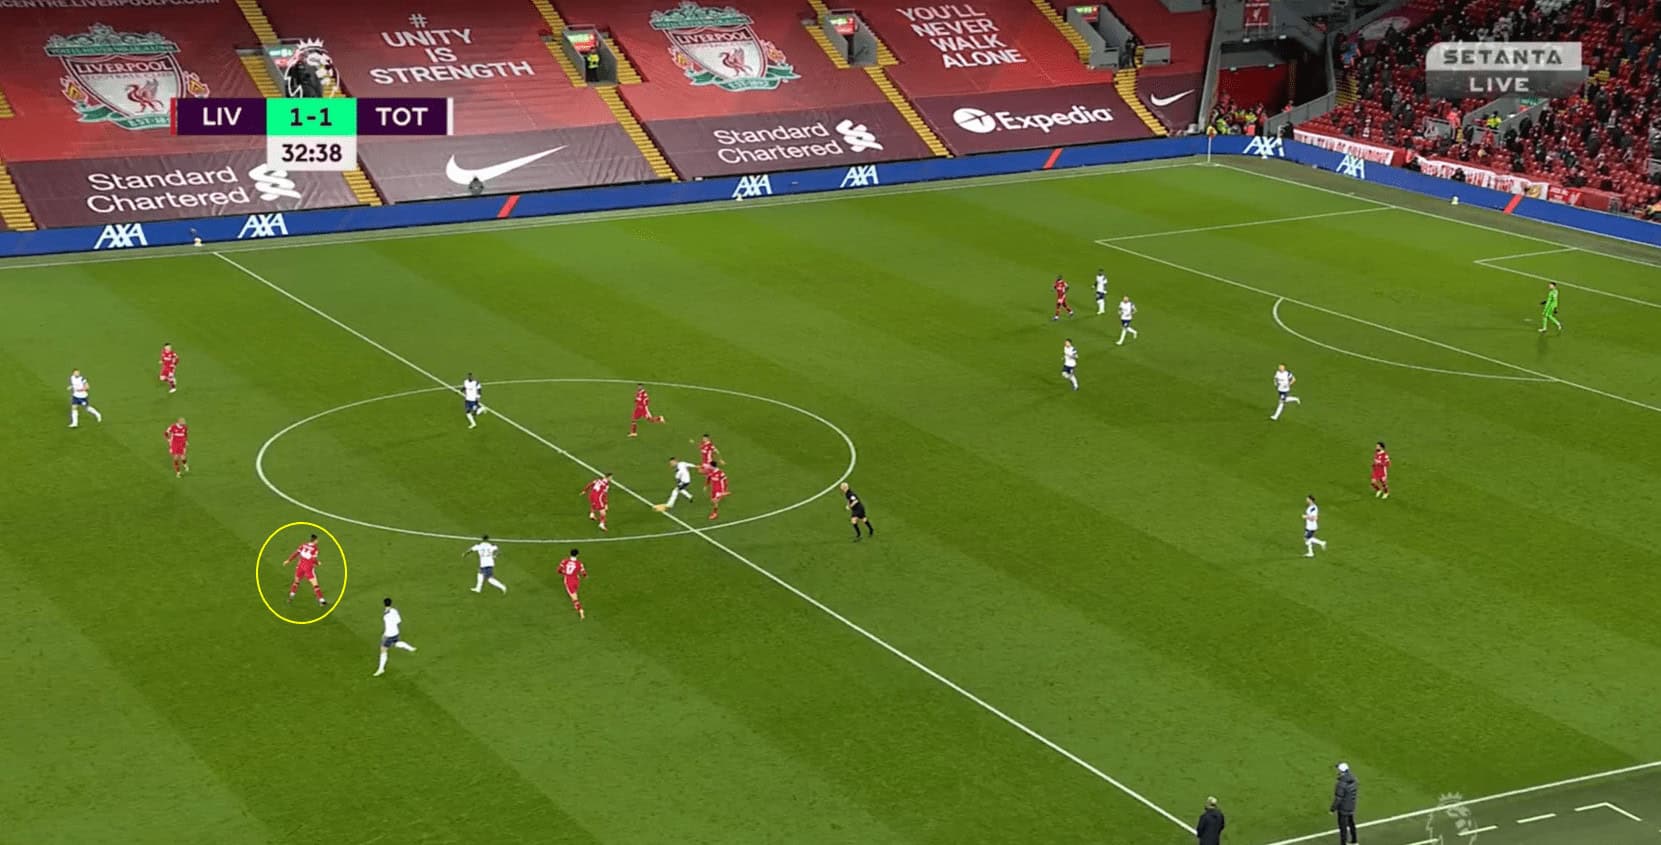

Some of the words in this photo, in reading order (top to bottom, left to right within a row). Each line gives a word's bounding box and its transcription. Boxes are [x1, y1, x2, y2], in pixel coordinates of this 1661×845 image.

[408, 13, 428, 28] #
[896, 4, 986, 21] YOU'LL
[381, 28, 472, 47] UNITY
[678, 30, 751, 44] LIVERPOOL
[910, 18, 1000, 37] NEVER
[929, 33, 1008, 52] WALK
[76, 60, 173, 73] LIVERPOOL
[424, 47, 458, 63] IS
[942, 48, 1027, 68] ALONE
[370, 60, 535, 84] STRENGTH
[995, 105, 1114, 133] Expedia
[713, 122, 830, 145] Standard
[718, 140, 844, 164] Chartered
[1242, 136, 1285, 157] AXA
[840, 165, 879, 188] AXA
[1336, 153, 1366, 179] AXA
[88, 166, 239, 191] Standard
[732, 174, 773, 198] AXA
[87, 187, 250, 213] Chartered
[94, 223, 148, 250] AXA
[238, 213, 289, 239] AXA
